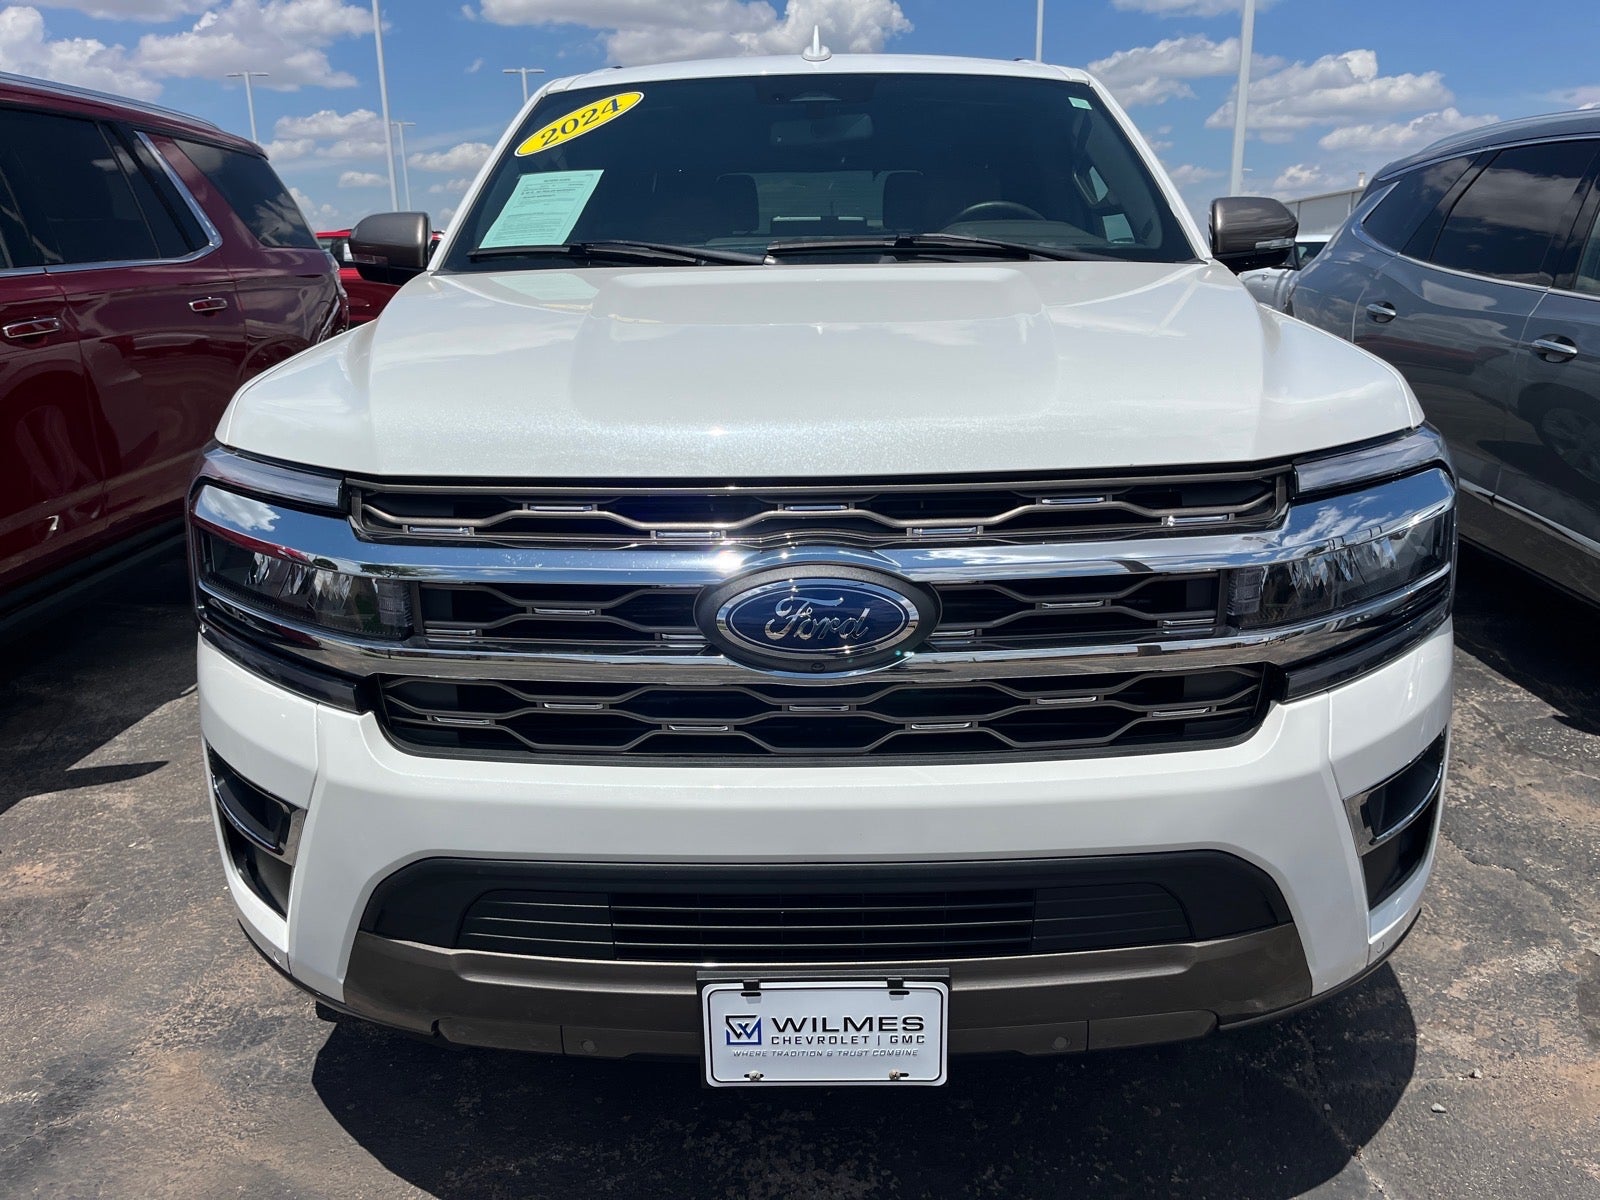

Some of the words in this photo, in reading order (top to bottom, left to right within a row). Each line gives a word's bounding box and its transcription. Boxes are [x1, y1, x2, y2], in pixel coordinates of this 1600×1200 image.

[541, 98, 623, 147] 2024
[764, 597, 871, 640] Ford
[771, 1016, 925, 1033] WILMES
[771, 1035, 870, 1045] CHEVROLET
[889, 1035, 925, 1045] GMC
[836, 1049, 869, 1057] TRUST
[872, 1049, 919, 1057] COMBINE
